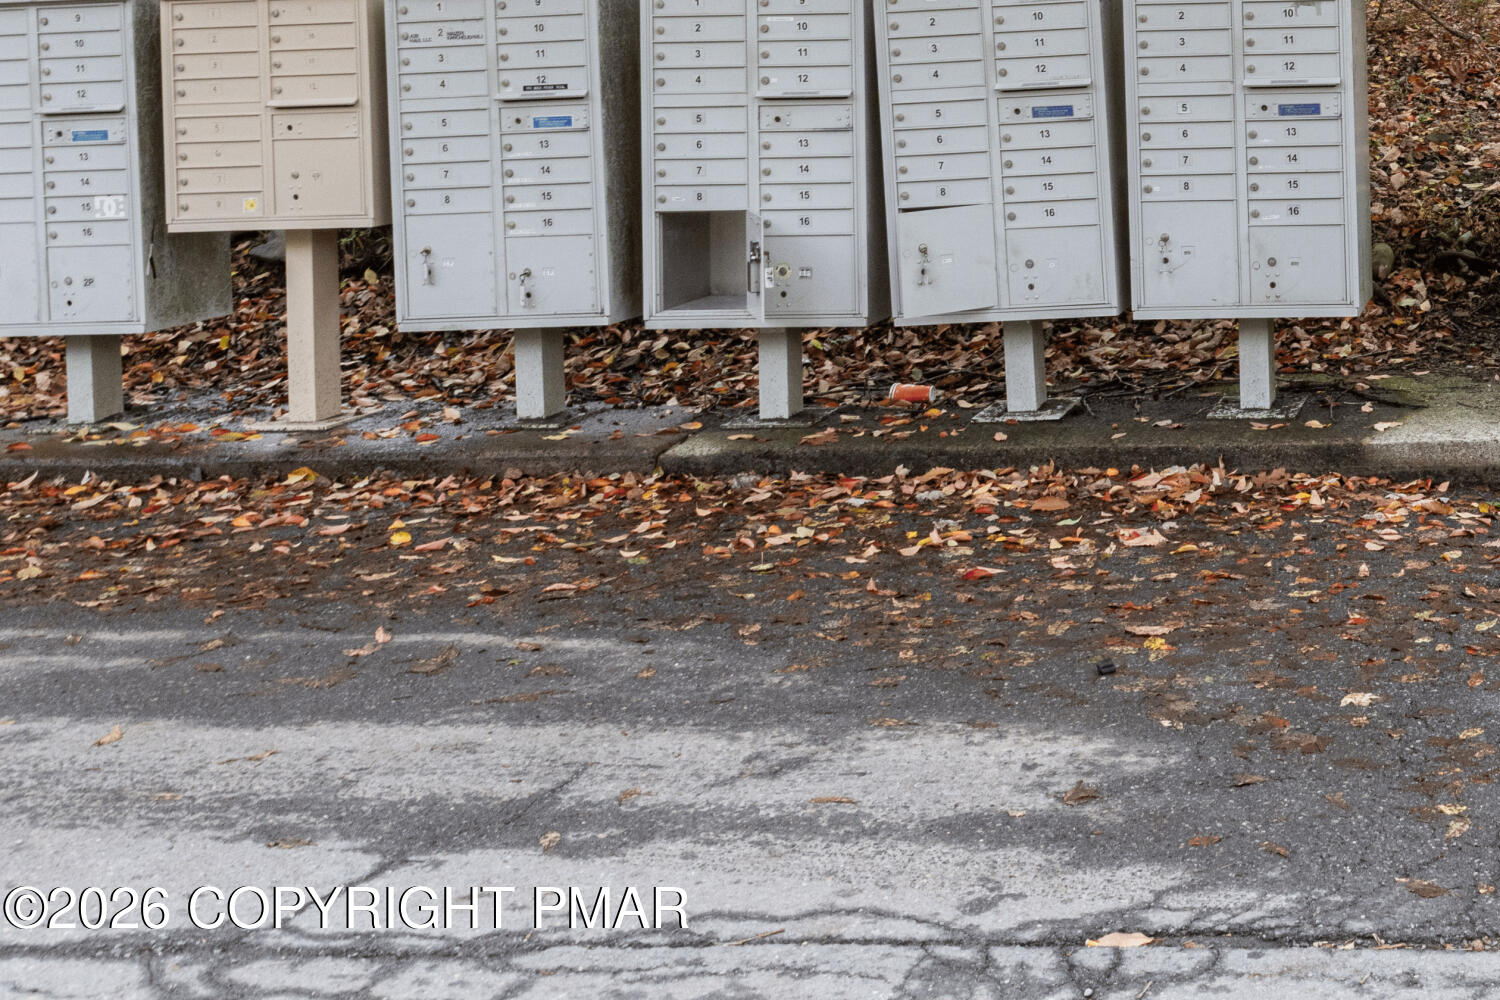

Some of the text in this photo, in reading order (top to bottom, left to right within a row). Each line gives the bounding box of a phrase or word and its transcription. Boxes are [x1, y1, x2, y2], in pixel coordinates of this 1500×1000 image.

[436, 2, 442, 11] 1
[74, 13, 81, 23] 9
[1032, 11, 1044, 21] 10
[1178, 11, 1185, 20] 2
[1282, 8, 1294, 18] 10
[796, 21, 808, 31] 10
[929, 17, 936, 27] 2
[437, 27, 444, 37] 2
[533, 23, 545, 33] 10
[695, 23, 701, 33] 2
[74, 39, 85, 48] 10
[1034, 37, 1045, 47] 11
[1179, 37, 1186, 47] 3
[1283, 35, 1294, 44] 11
[797, 48, 808, 57] 11
[931, 43, 938, 53] 3
[438, 53, 445, 63] 3
[535, 49, 545, 58] 11
[695, 49, 701, 59] 3
[75, 64, 85, 73] 11
[1035, 64, 1047, 73] 12
[1179, 63, 1186, 72] 4
[1283, 61, 1295, 71] 12
[797, 73, 809, 83] 12
[932, 69, 939, 79] 4
[439, 79, 446, 88] 4
[536, 75, 547, 84] 12
[695, 75, 702, 84] 4
[76, 89, 87, 99] 12
[1181, 103, 1188, 112] 5
[696, 113, 702, 123] 5
[935, 108, 942, 118] 5
[441, 118, 448, 127] 5
[1039, 129, 1051, 139] 13
[1182, 129, 1189, 138] 6
[1285, 127, 1297, 137] 13
[539, 139, 550, 149] 13
[798, 138, 809, 148] 13
[936, 135, 943, 144] 6
[442, 143, 449, 153] 6
[696, 140, 703, 150] 6
[79, 152, 89, 161] 13
[1041, 155, 1052, 165] 14
[1182, 155, 1189, 165] 7
[1287, 153, 1298, 163] 14
[540, 165, 551, 175] 14
[696, 165, 703, 175] 7
[799, 164, 810, 173] 14
[938, 161, 945, 170] 7
[443, 169, 449, 179] 7
[80, 177, 90, 186] 14
[1042, 181, 1054, 191] 15
[1183, 181, 1190, 191] 8
[1287, 179, 1299, 189] 15
[541, 191, 553, 201] 15
[696, 192, 703, 201] 8
[799, 190, 810, 200] 15
[940, 187, 947, 197] 8
[444, 194, 451, 205] 8
[80, 202, 92, 212] 15
[1288, 206, 1300, 216] 16
[1044, 208, 1056, 217] 16
[542, 218, 553, 227] 16
[799, 216, 810, 226] 16
[82, 227, 93, 237] 16
